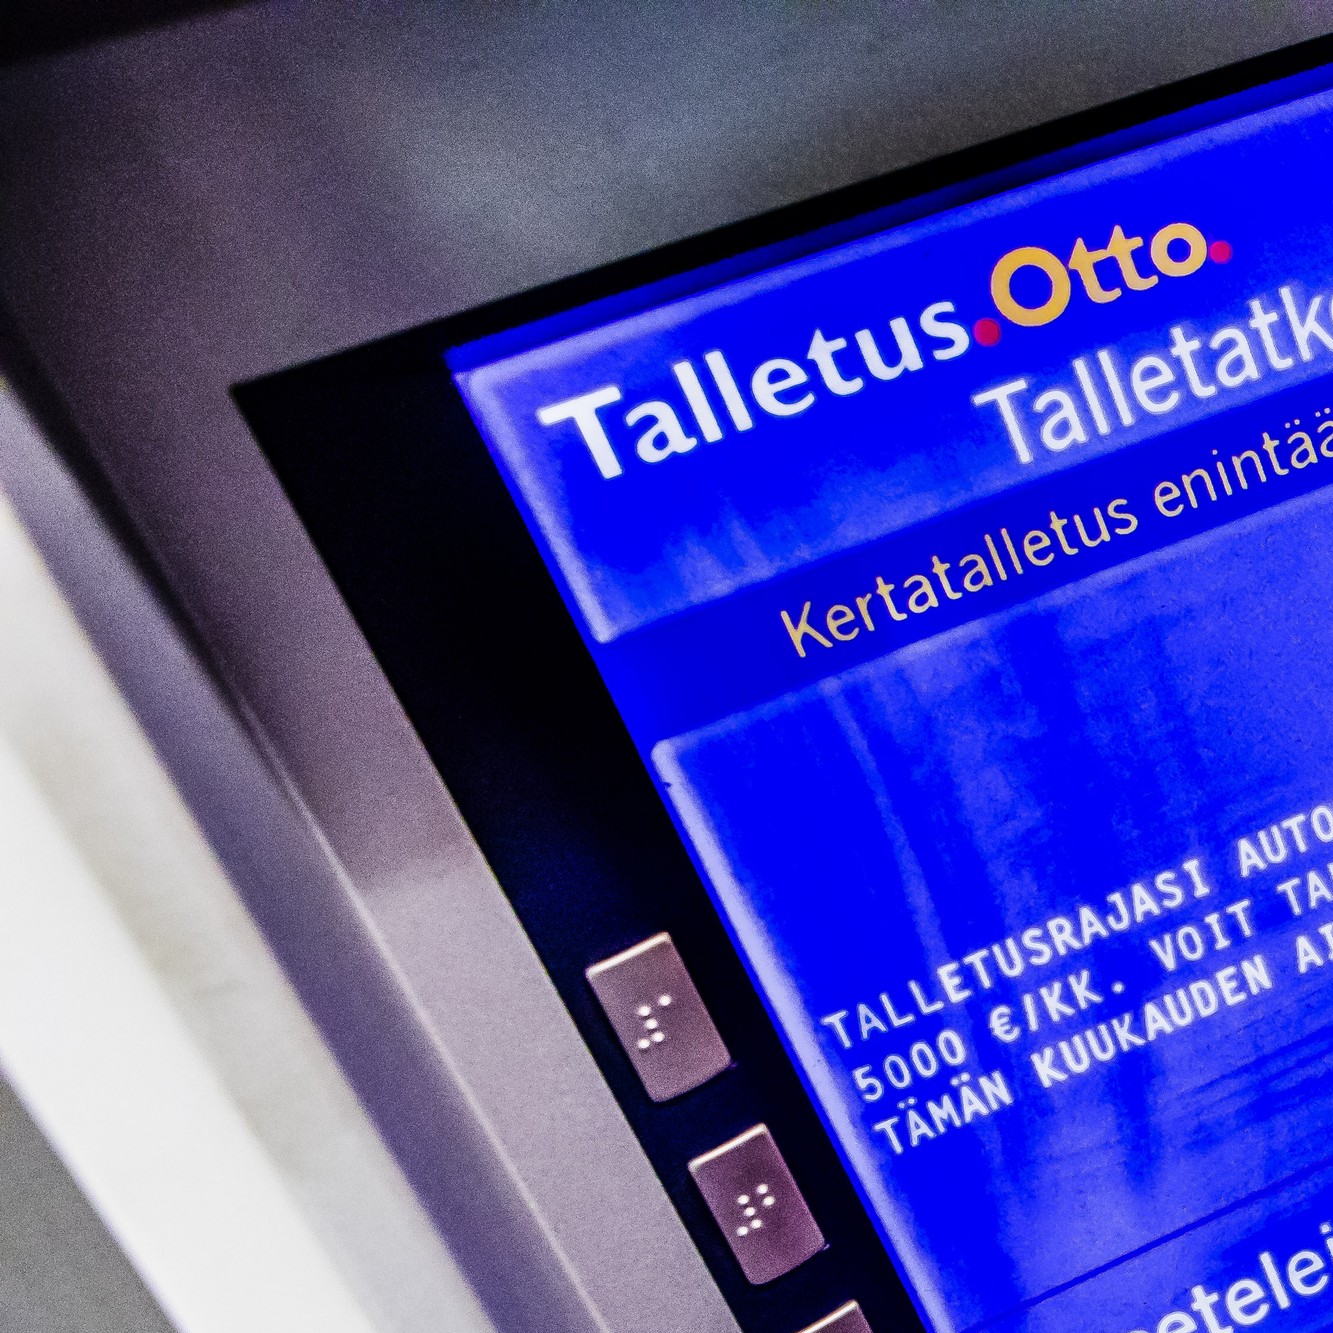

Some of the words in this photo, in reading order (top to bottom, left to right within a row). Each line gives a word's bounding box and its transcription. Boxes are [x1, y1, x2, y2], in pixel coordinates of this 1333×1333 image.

[781, 499, 1137, 656] Kertatalletus
[824, 860, 1209, 1046] TALLETUSRAJASI
[855, 1030, 965, 1100] 5000
[1150, 901, 1251, 970] VOIT
[875, 1073, 1012, 1152] TÄMÄN
[1031, 955, 1272, 1087] KUUKAUDEN
